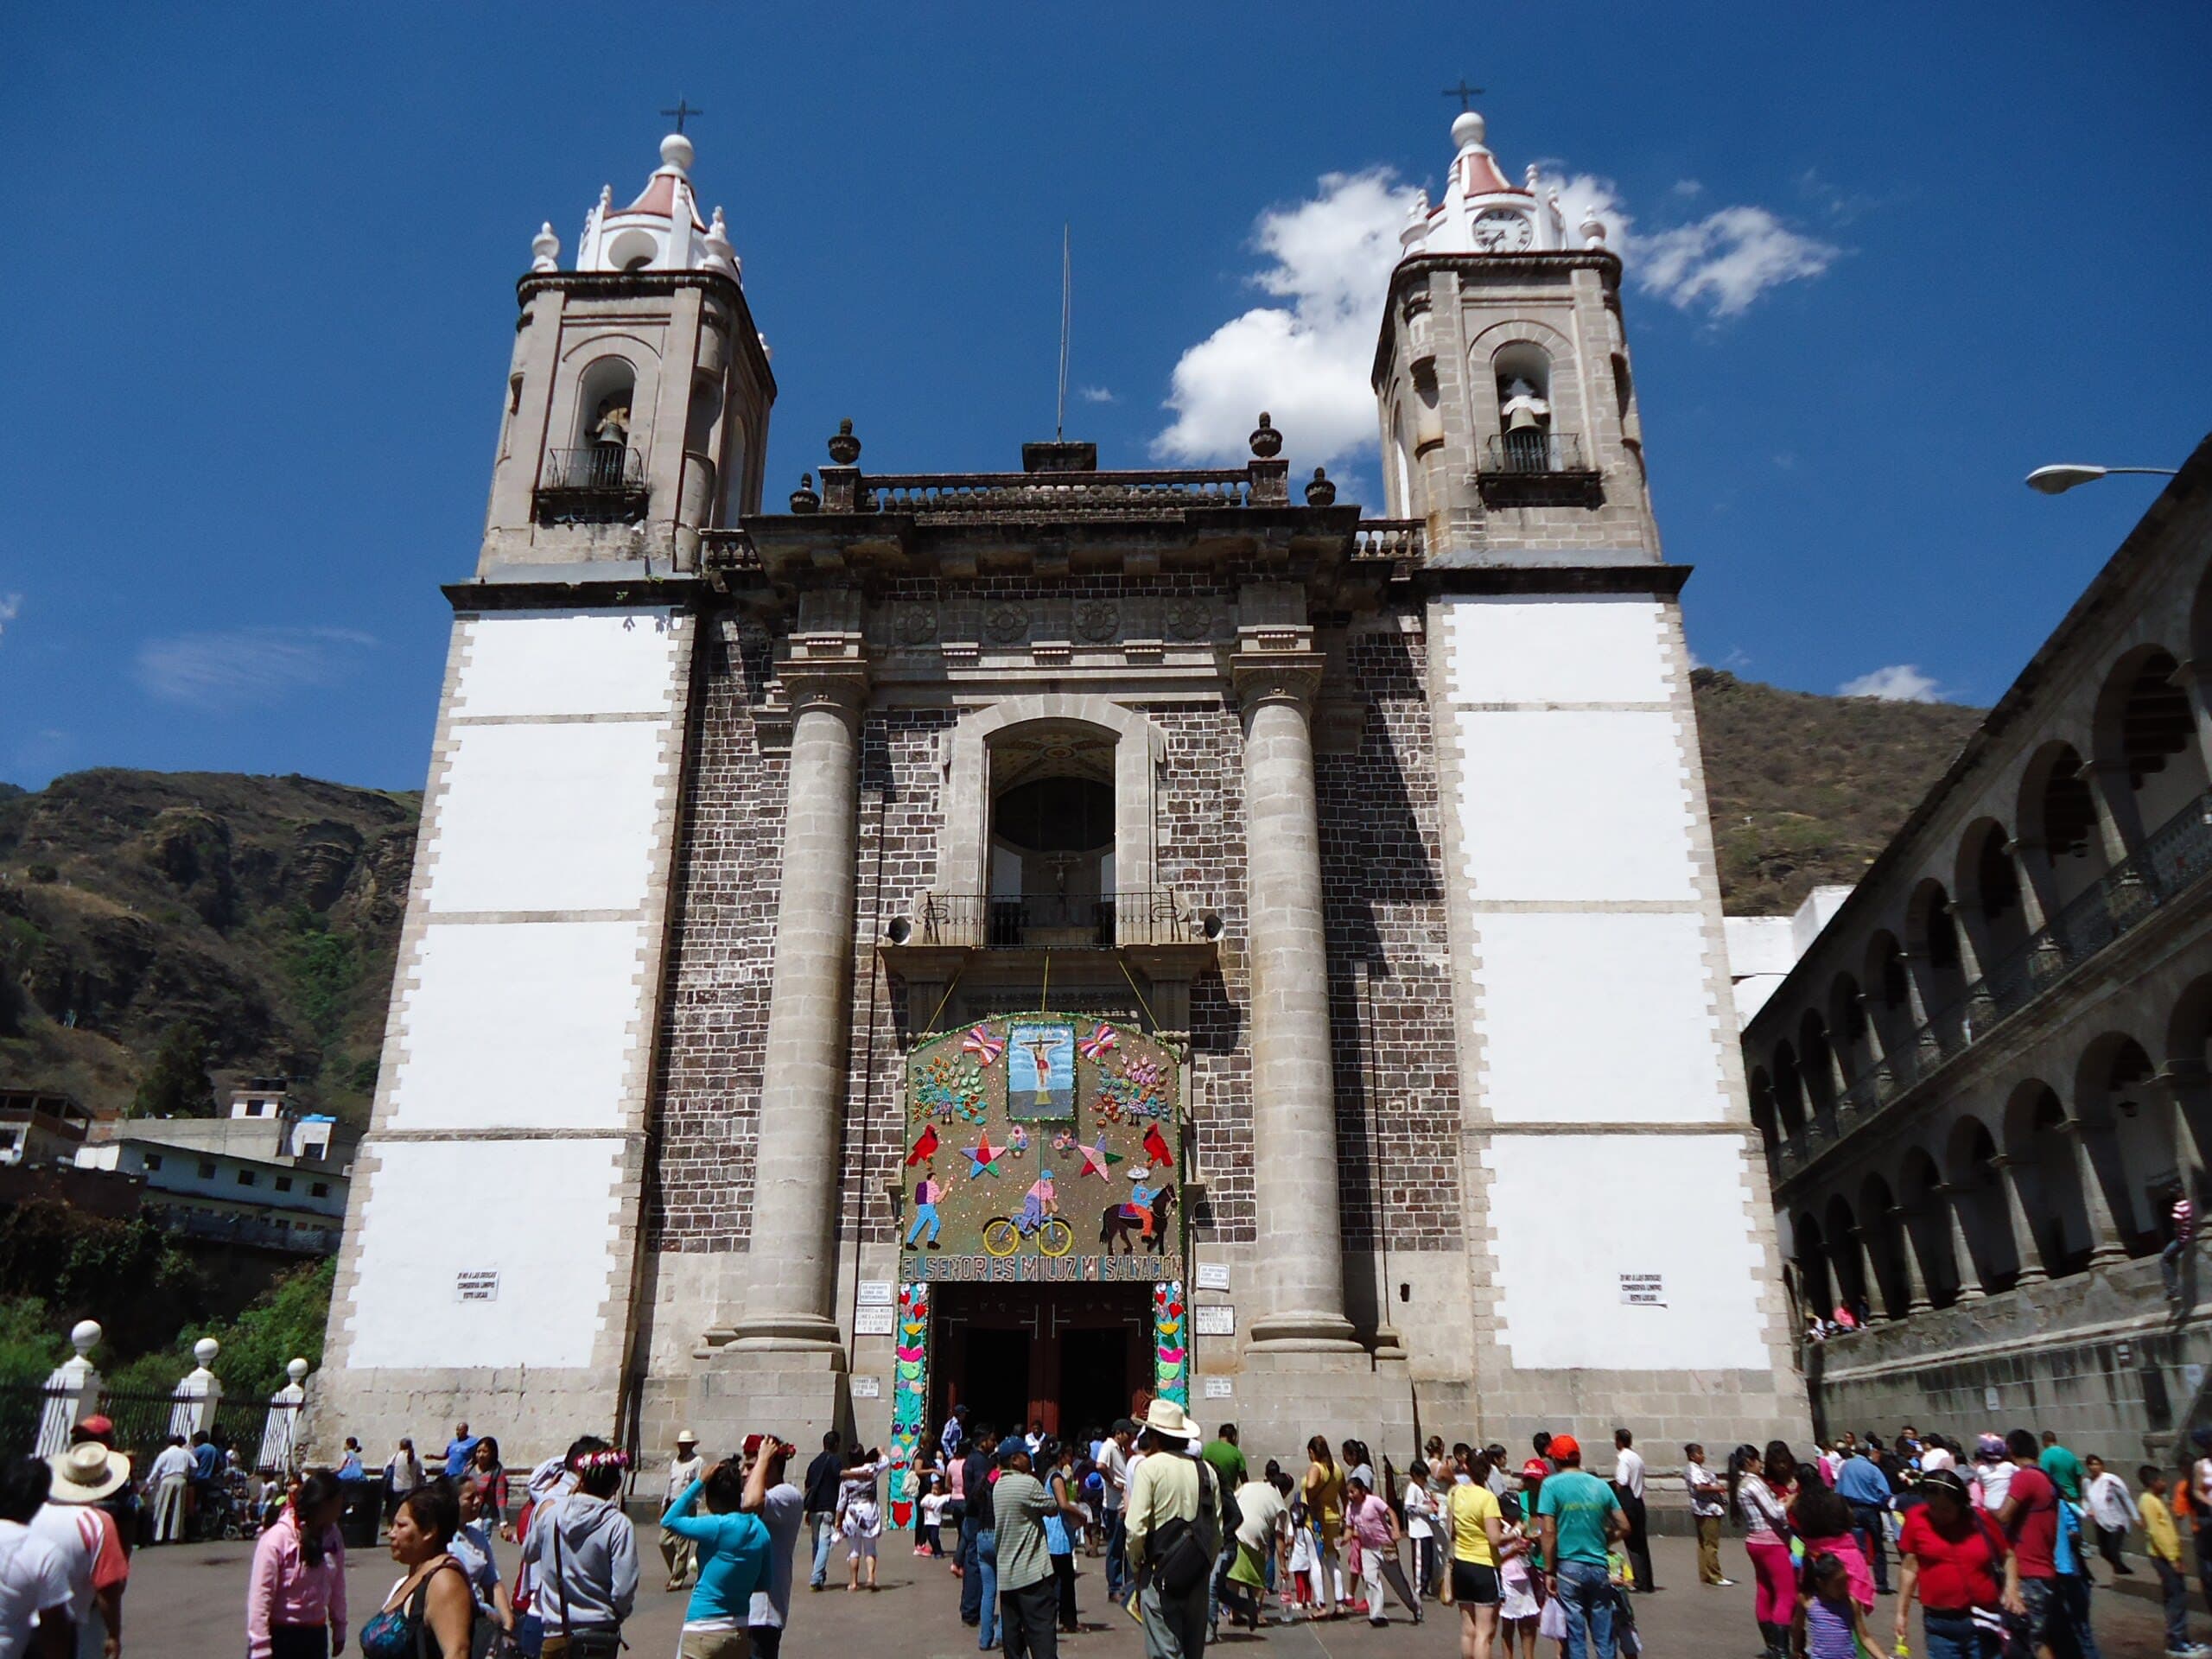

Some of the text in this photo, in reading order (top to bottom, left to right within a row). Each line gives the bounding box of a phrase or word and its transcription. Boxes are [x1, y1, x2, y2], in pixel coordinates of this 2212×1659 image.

[902, 1255, 921, 1281] EL
[991, 1255, 1016, 1281] ES
[1020, 1255, 1045, 1281] MI
[1046, 1255, 1077, 1281] LUZ
